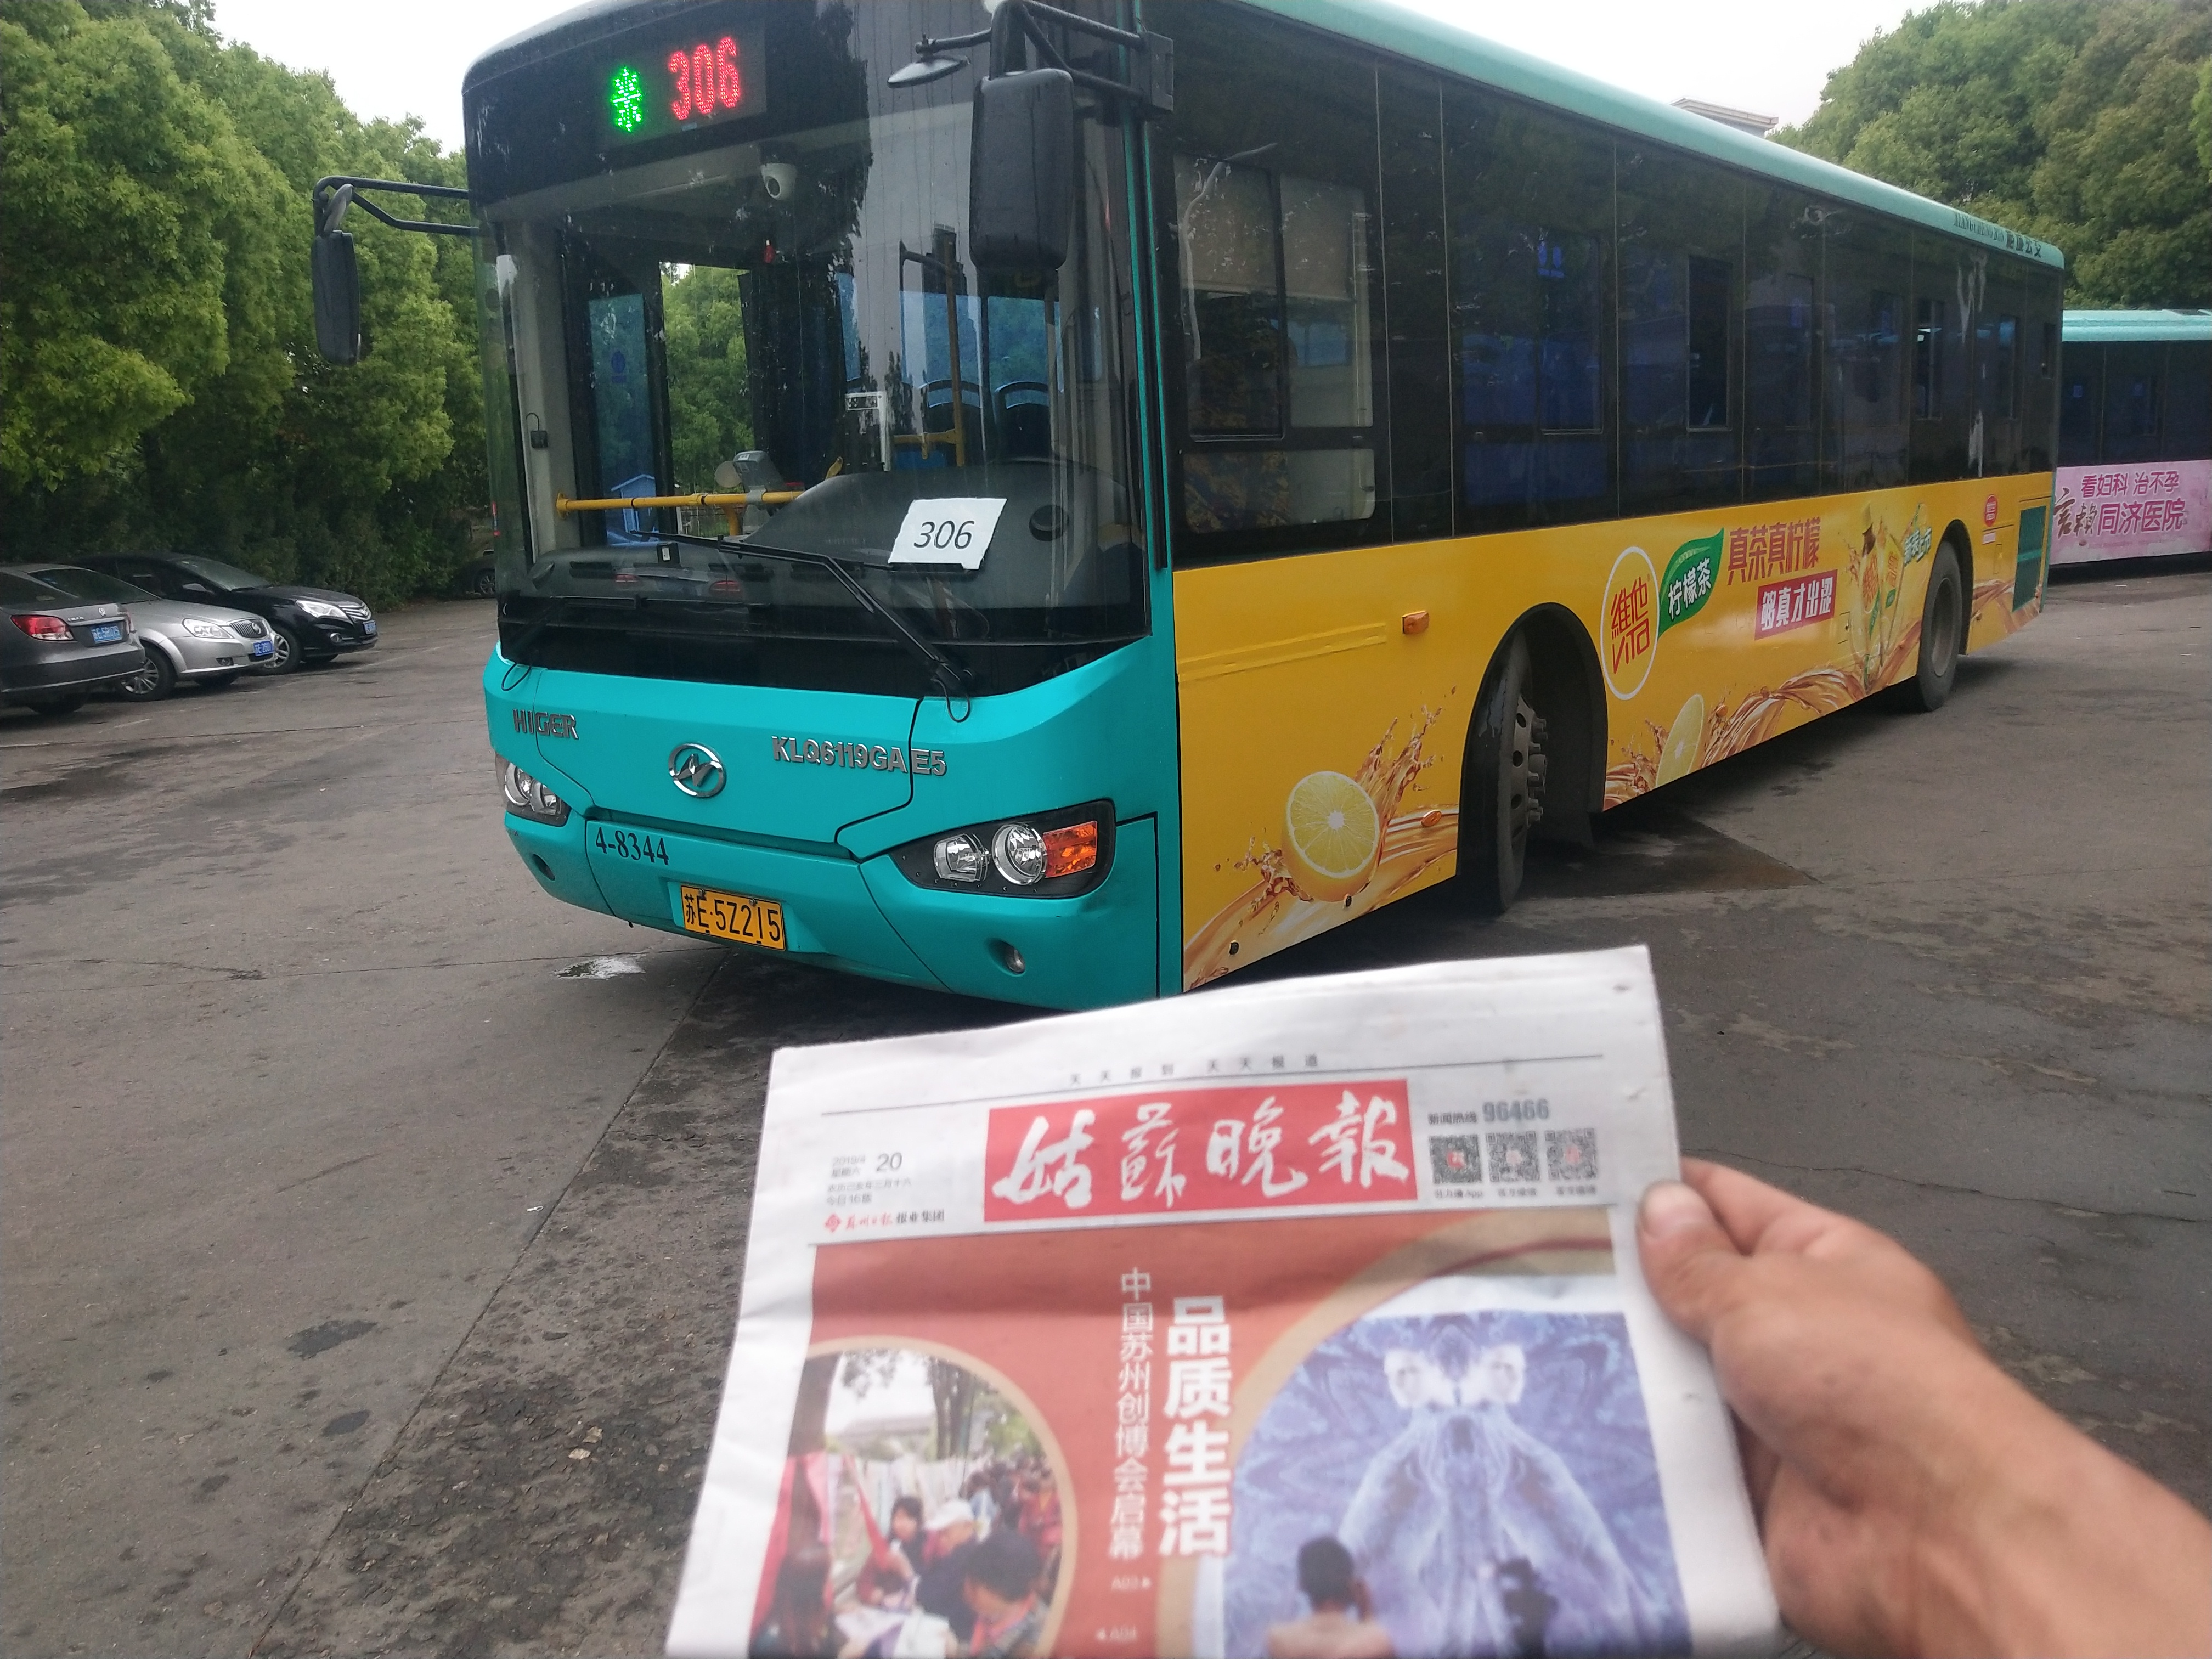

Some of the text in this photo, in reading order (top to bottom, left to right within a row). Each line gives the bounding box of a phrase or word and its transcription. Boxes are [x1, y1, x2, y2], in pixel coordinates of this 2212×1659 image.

[669, 37, 740, 120] 306
[2081, 470, 2179, 498] 看妇科 治不孕
[913, 520, 975, 549] 306
[2097, 497, 2186, 536] 同济医院
[1727, 516, 1821, 586] 真茶真柠檬
[1668, 557, 1712, 620] 柠檬茶
[1760, 576, 1833, 631] 够真才出涩
[512, 708, 579, 740] HIGER
[595, 826, 669, 866] 4-8344
[1482, 1098, 1549, 1122] 96466
[876, 1152, 903, 1172] 20
[1109, 1266, 1153, 1561] 中国苏州创博会启幕
[1158, 1295, 1232, 1556] 品质生活
